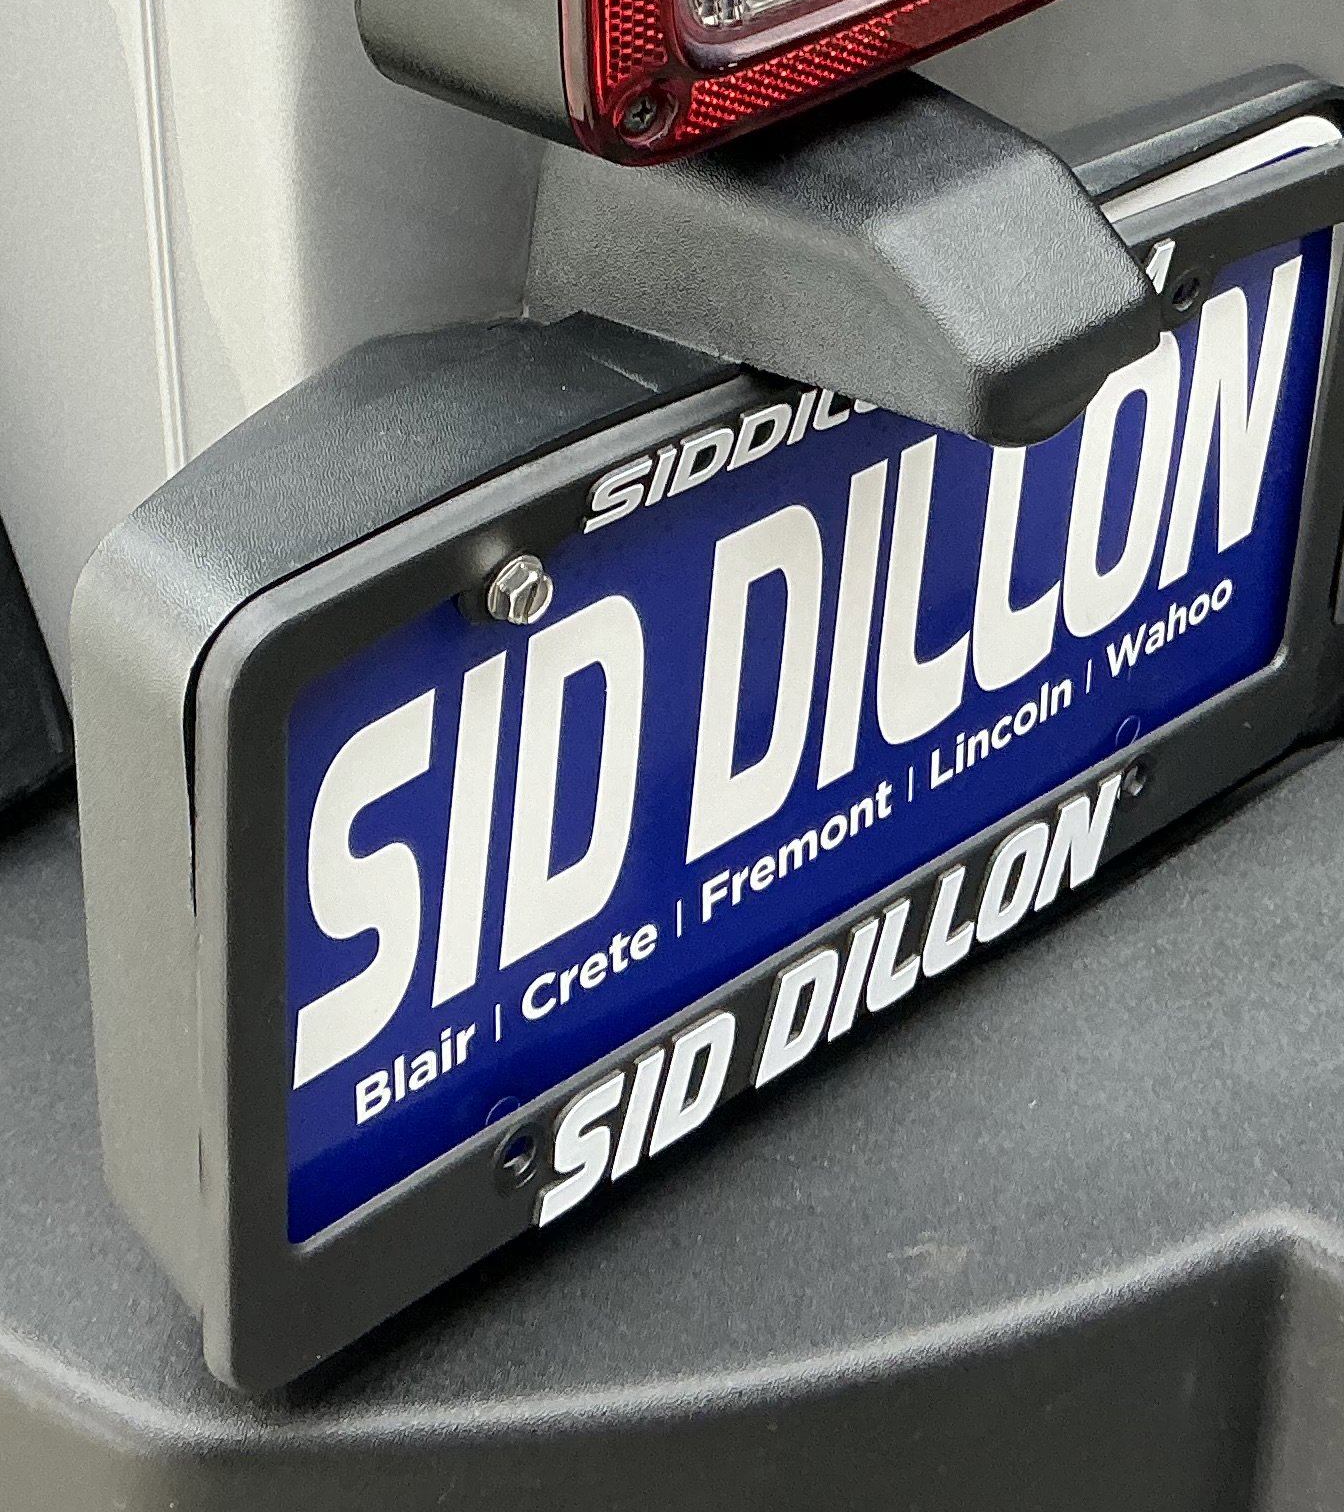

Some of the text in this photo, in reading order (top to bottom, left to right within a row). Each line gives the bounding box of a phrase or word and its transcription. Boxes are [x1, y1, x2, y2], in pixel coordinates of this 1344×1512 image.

[293, 254, 1303, 1090] SID DILLON
[356, 578, 1234, 1126] Blair Crete Fremont Lincoln Wahoo
[536, 773, 1122, 1229] SID DILLON
